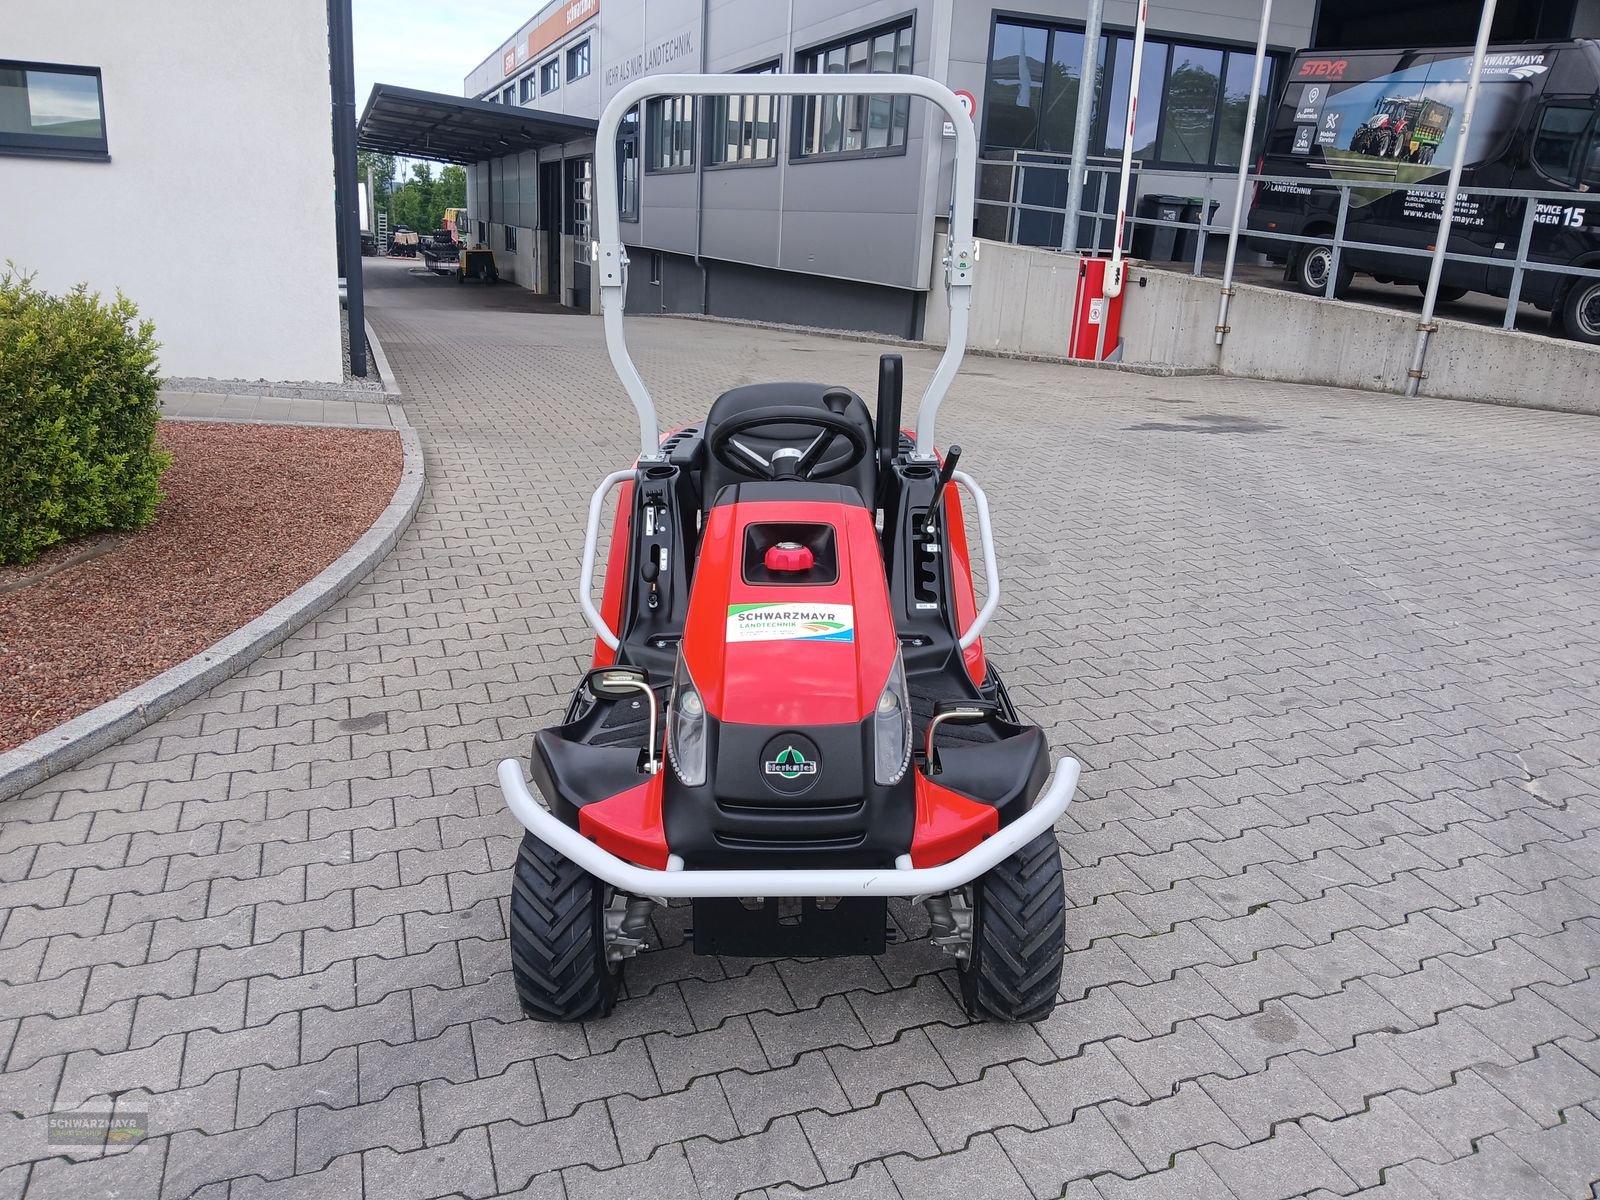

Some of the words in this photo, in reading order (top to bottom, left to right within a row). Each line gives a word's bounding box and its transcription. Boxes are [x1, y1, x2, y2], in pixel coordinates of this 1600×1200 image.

[605, 65, 619, 87] MEHR
[620, 60, 630, 81] ALS
[631, 54, 643, 77] NUR
[644, 31, 694, 71] LANDTECHNIK.
[1470, 54, 1544, 66] HWARZMAYR
[1299, 61, 1347, 75] STEYR
[1296, 139, 1309, 147] 24h
[1270, 184, 1312, 195] LANDTECHNIK
[1403, 209, 1485, 226] www.schwzmayr.at
[1533, 214, 1560, 224] AGEN
[1563, 206, 1586, 227] 15
[738, 612, 836, 621] SCHWARZMAYR
